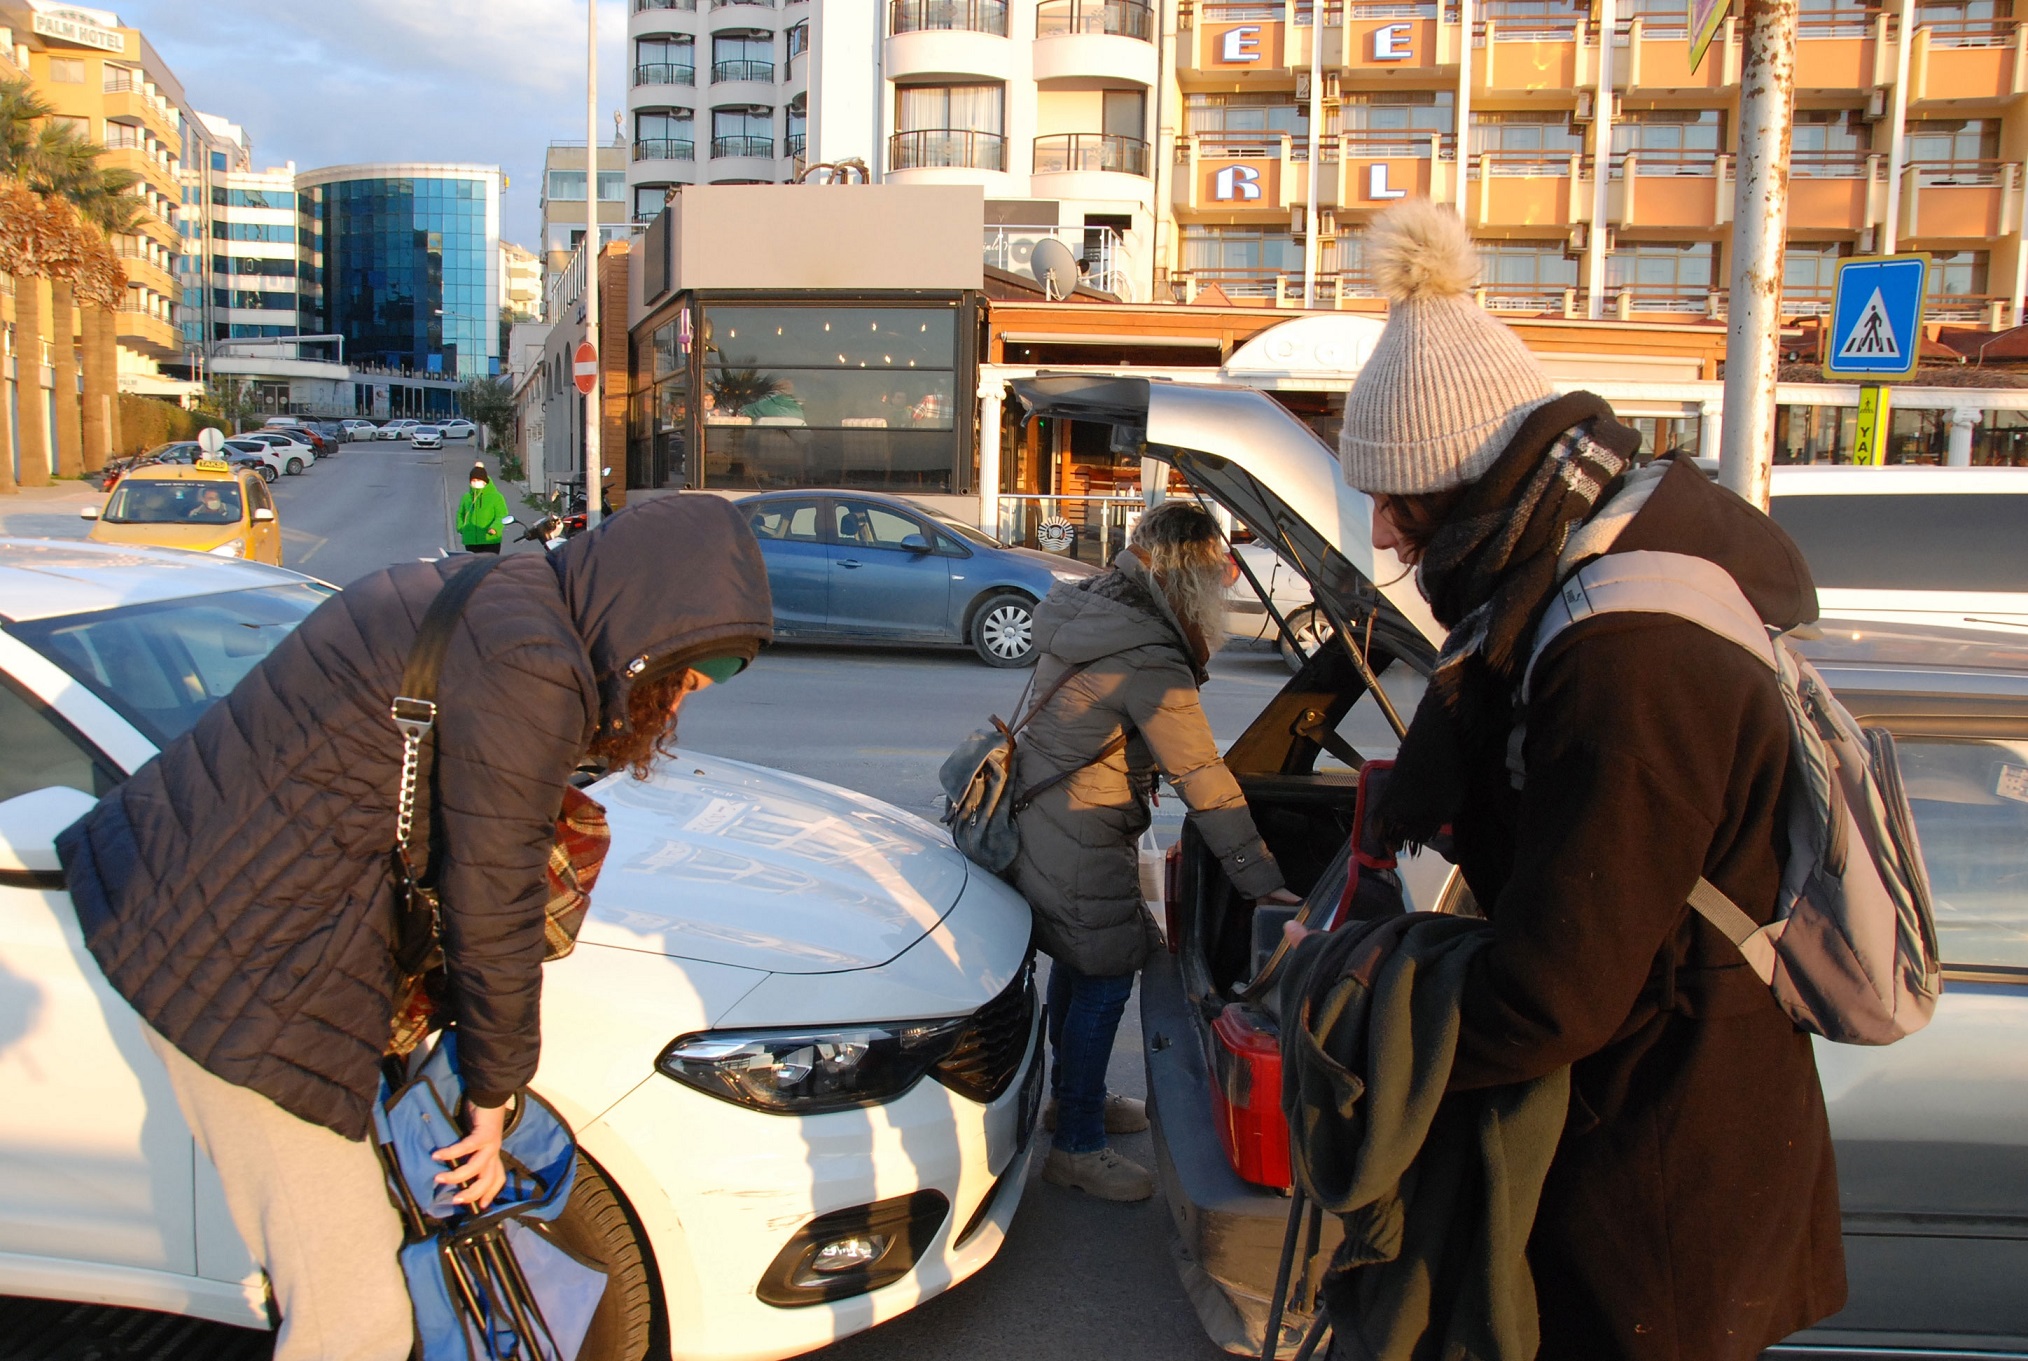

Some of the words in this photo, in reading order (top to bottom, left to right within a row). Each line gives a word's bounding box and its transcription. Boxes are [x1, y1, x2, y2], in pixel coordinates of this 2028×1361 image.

[36, 15, 76, 39] PALM
[78, 26, 123, 50] HOTEL
[1222, 25, 1261, 62] E
[1373, 22, 1414, 61] E
[1216, 164, 1262, 200] R
[1369, 163, 1408, 199] L
